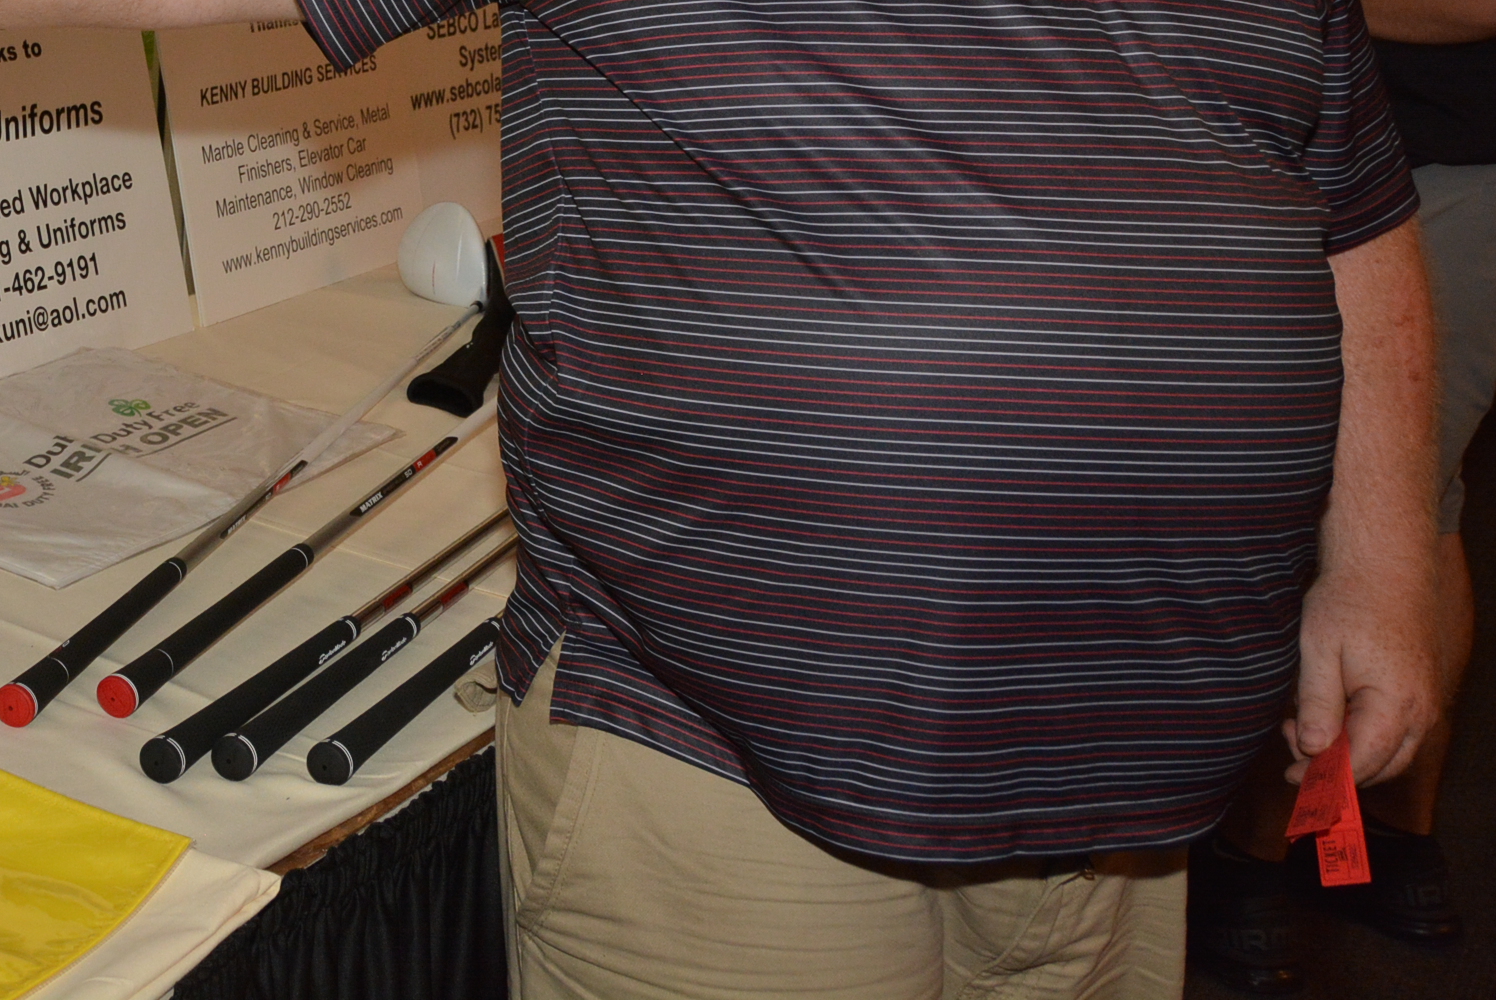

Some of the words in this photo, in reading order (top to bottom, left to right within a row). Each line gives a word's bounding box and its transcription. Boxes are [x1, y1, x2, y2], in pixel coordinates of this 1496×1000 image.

[426, 11, 479, 40] SEBCO
[22, 39, 43, 58] to
[200, 79, 247, 108] KENNY
[251, 67, 313, 96] BUILDING
[410, 73, 502, 111] www.sebcola
[201, 139, 245, 165] Marble
[247, 127, 299, 154] Cleaning
[302, 122, 312, 139] &
[313, 113, 359, 137] Service,
[360, 103, 390, 126] Metal
[449, 107, 484, 140] (732)
[485, 103, 502, 126] 75
[238, 157, 296, 184] Finishers,
[299, 145, 344, 169] Elevator
[346, 136, 366, 154] Car
[28, 169, 134, 212] Workplace
[216, 186, 297, 219] Maintenance,
[298, 170, 344, 195] Window
[346, 156, 394, 182] Cleaning
[272, 191, 352, 231] 212-290-2552
[17, 228, 33, 255] &
[36, 210, 127, 250] Uniforms
[222, 205, 403, 274] www.kennybuildingservices.com
[90, 416, 153, 444] Duty
[153, 401, 200, 421] Free
[139, 407, 230, 447] OPEN
[359, 491, 383, 513] MATRIX
[1322, 840, 1339, 874] TICKET
